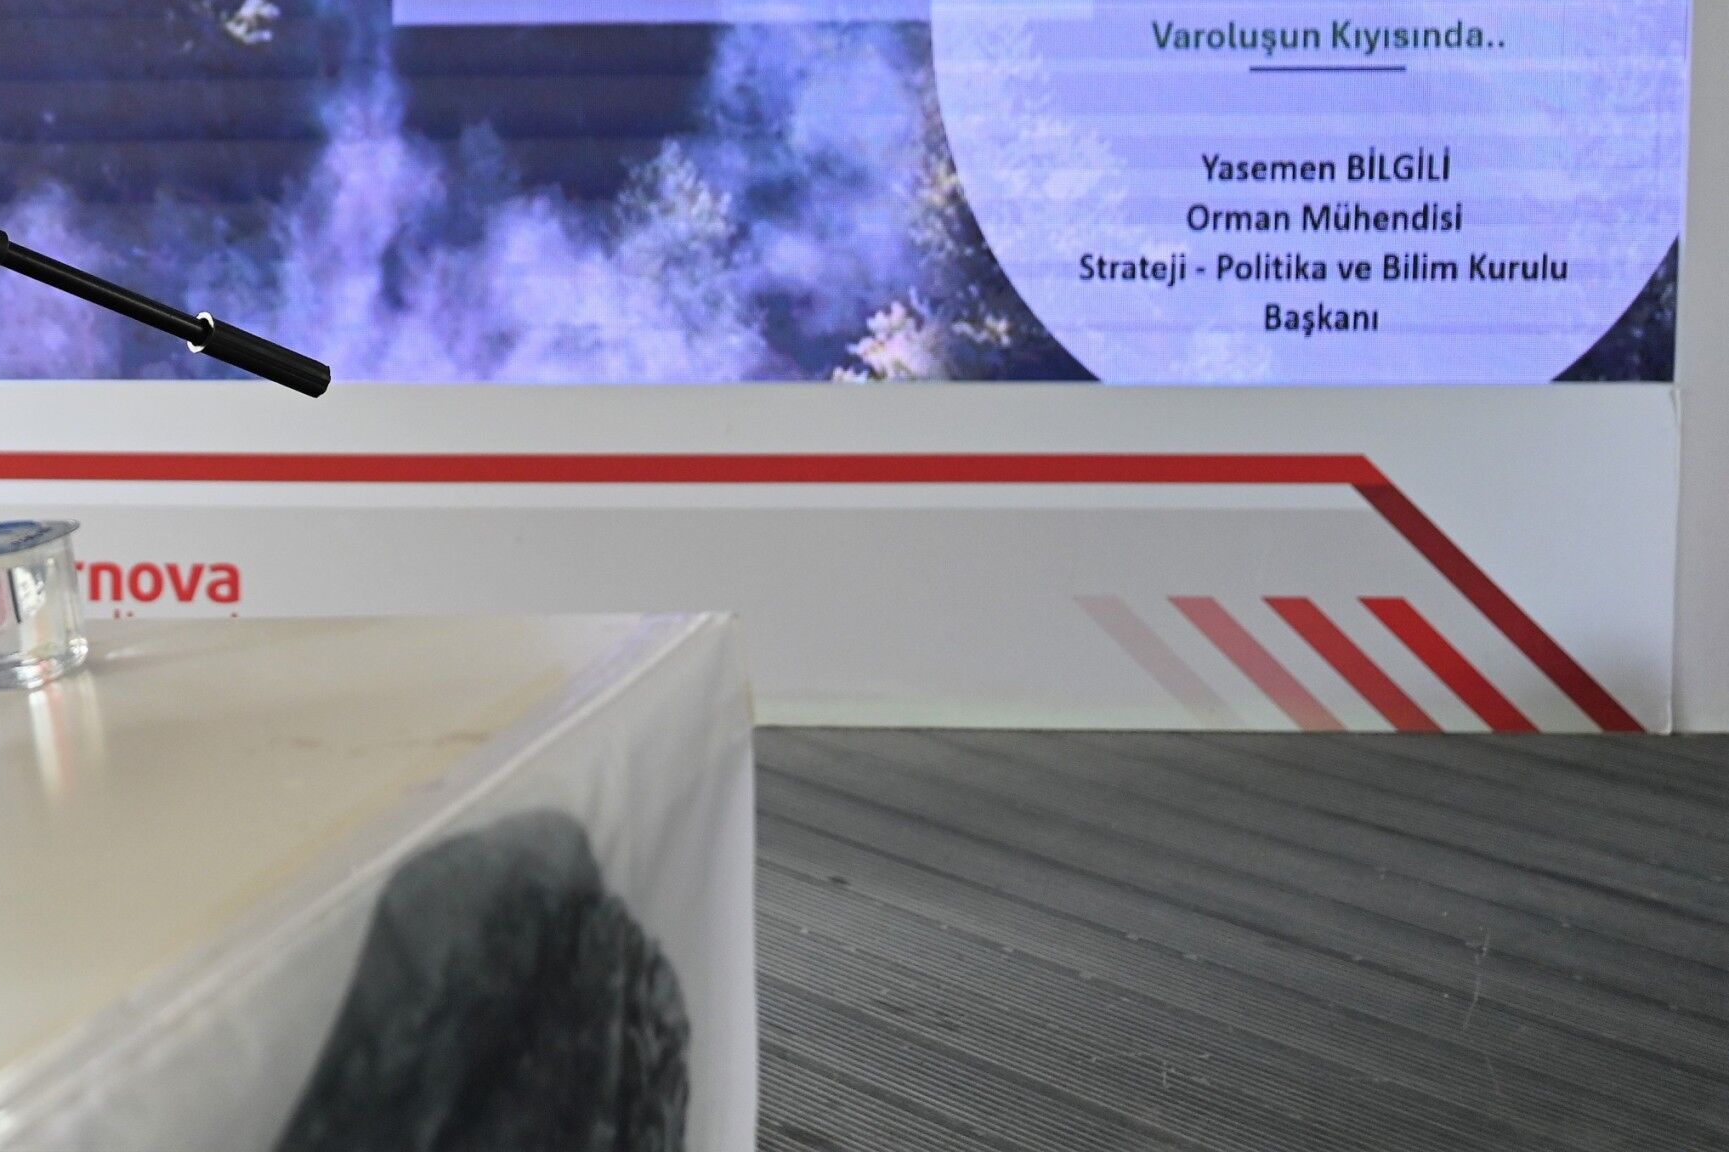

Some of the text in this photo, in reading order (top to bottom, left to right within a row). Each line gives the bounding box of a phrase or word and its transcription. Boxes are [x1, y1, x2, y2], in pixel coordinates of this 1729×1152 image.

[1150, 20, 1506, 57] Varoluşun Kıyısında..
[1200, 146, 1451, 182] Yasemen BİLGİLİ
[1185, 202, 1463, 232] Orman Mühendisi
[1078, 252, 1187, 288] Strateji
[1216, 252, 1328, 282] Politika
[1337, 259, 1373, 282] ve
[1382, 252, 1459, 282] Bilim
[1468, 252, 1569, 282] Kurulu
[1263, 302, 1380, 337] Başkanı
